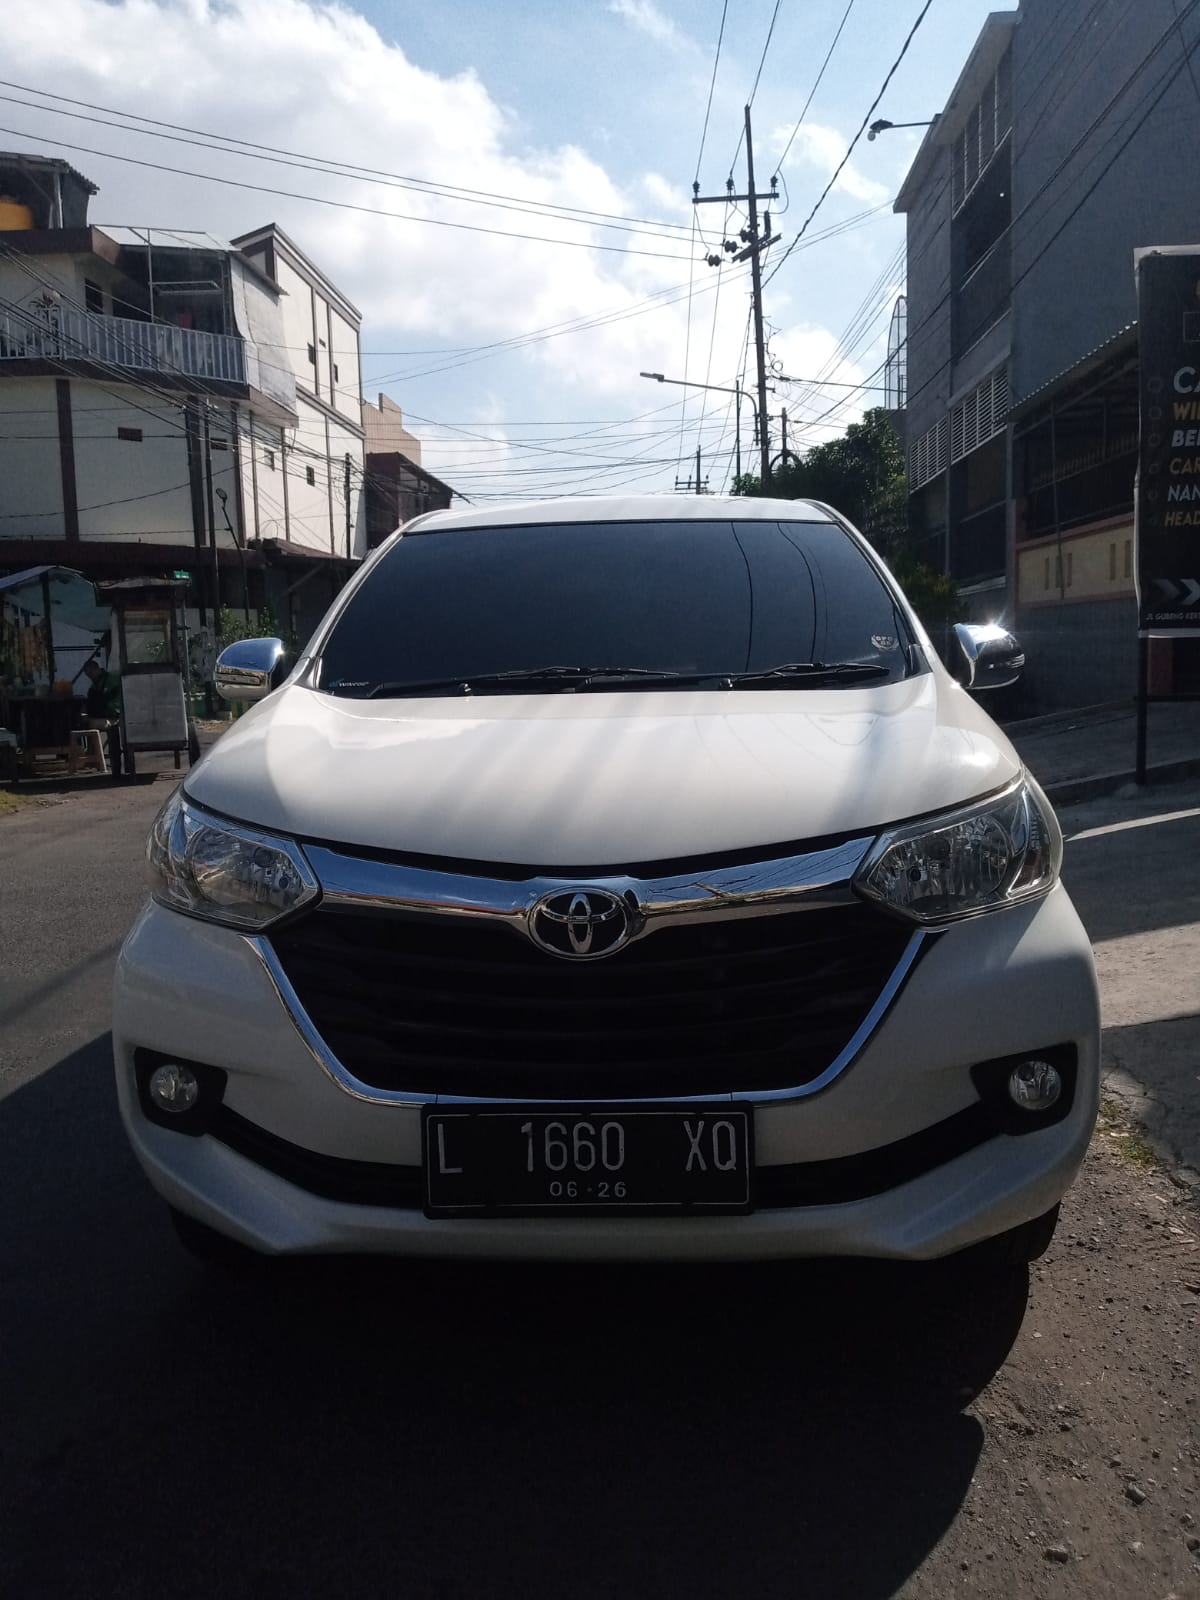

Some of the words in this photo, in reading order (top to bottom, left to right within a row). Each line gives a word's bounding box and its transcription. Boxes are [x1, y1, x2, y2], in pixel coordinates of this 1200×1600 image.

[437, 1123, 463, 1174] L
[521, 1121, 625, 1172] 1660
[683, 1120, 737, 1172] XQ
